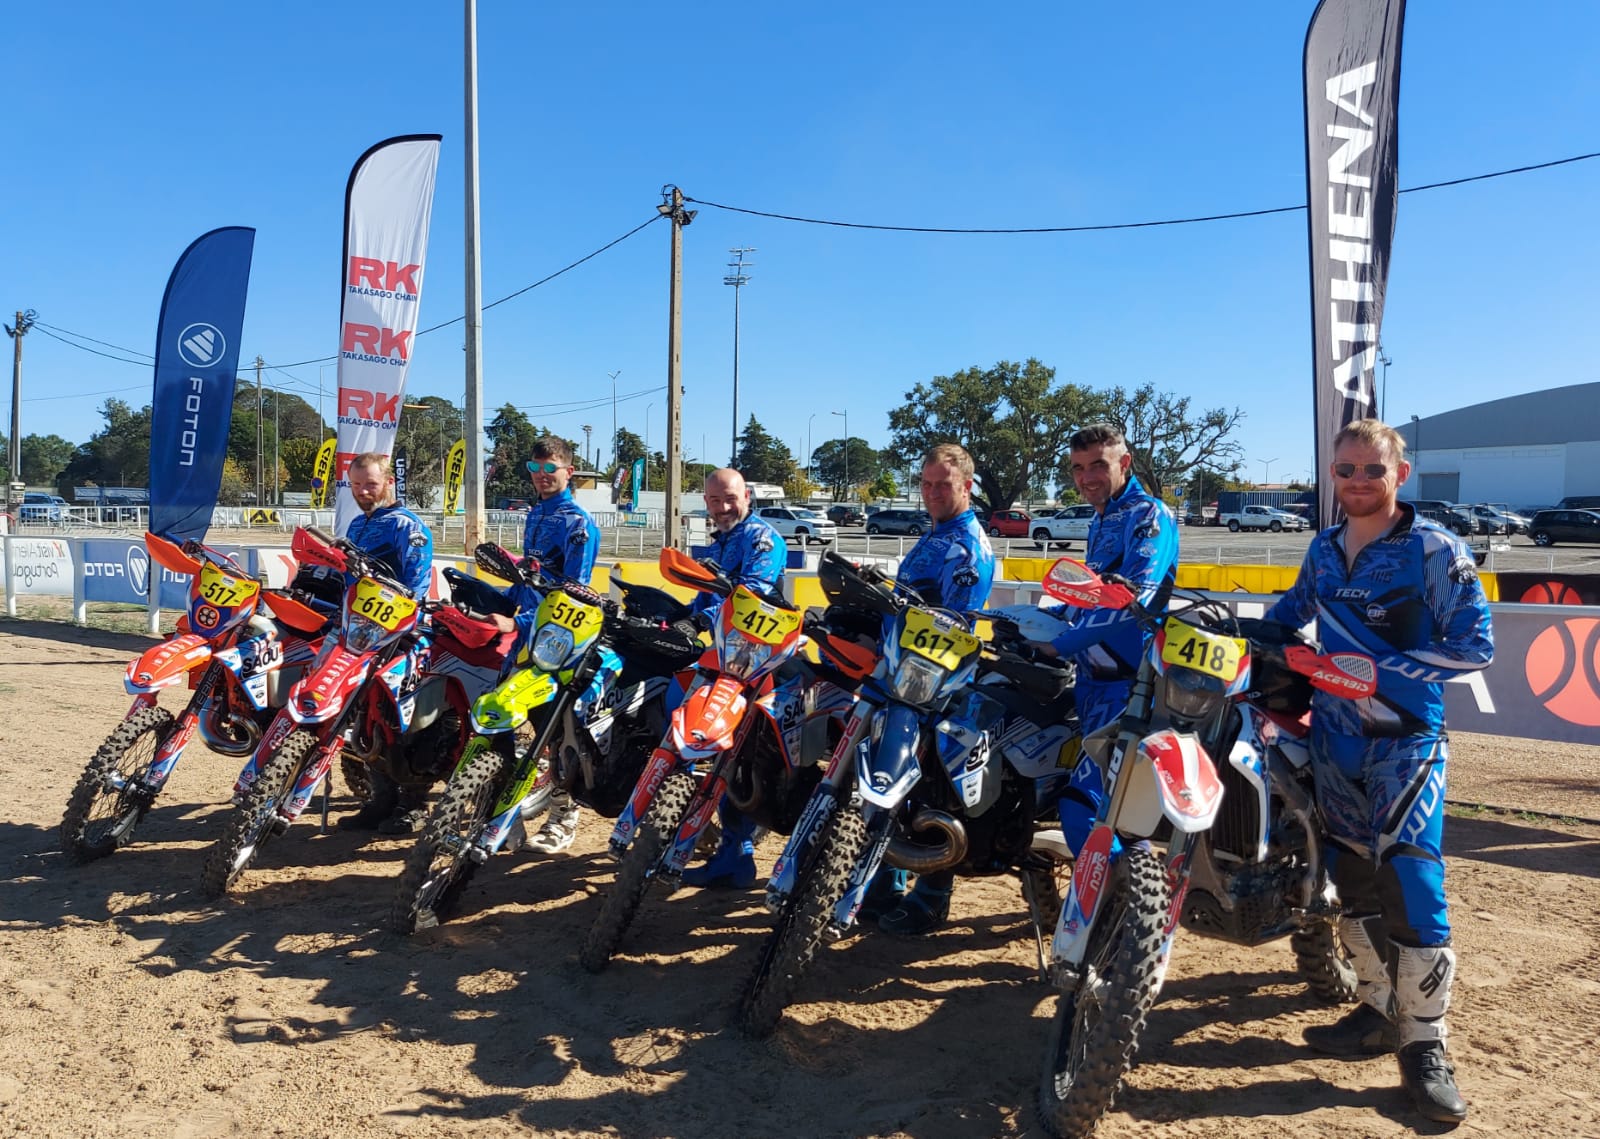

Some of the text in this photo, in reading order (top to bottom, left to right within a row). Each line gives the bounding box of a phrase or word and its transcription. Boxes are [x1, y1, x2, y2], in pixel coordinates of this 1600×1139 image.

[1325, 61, 1377, 405] ATHENA
[349, 256, 420, 295] RK
[348, 285, 392, 299] TAKASAGO
[343, 322, 412, 360] RK
[342, 351, 388, 365] TAKASAGO
[337, 387, 400, 422] RK
[179, 376, 203, 467] FOTON
[338, 416, 380, 429] TAKASAGO
[205, 582, 236, 605] 517
[1048, 583, 1100, 603] ACERBIS
[1335, 588, 1371, 598] TECH
[362, 597, 394, 623] 618
[552, 603, 586, 628] 518
[742, 610, 779, 637] 417
[914, 628, 955, 659] 617
[1178, 638, 1225, 672] 418
[1312, 670, 1369, 692] ACERBIS
[1089, 852, 1107, 892] SACU
